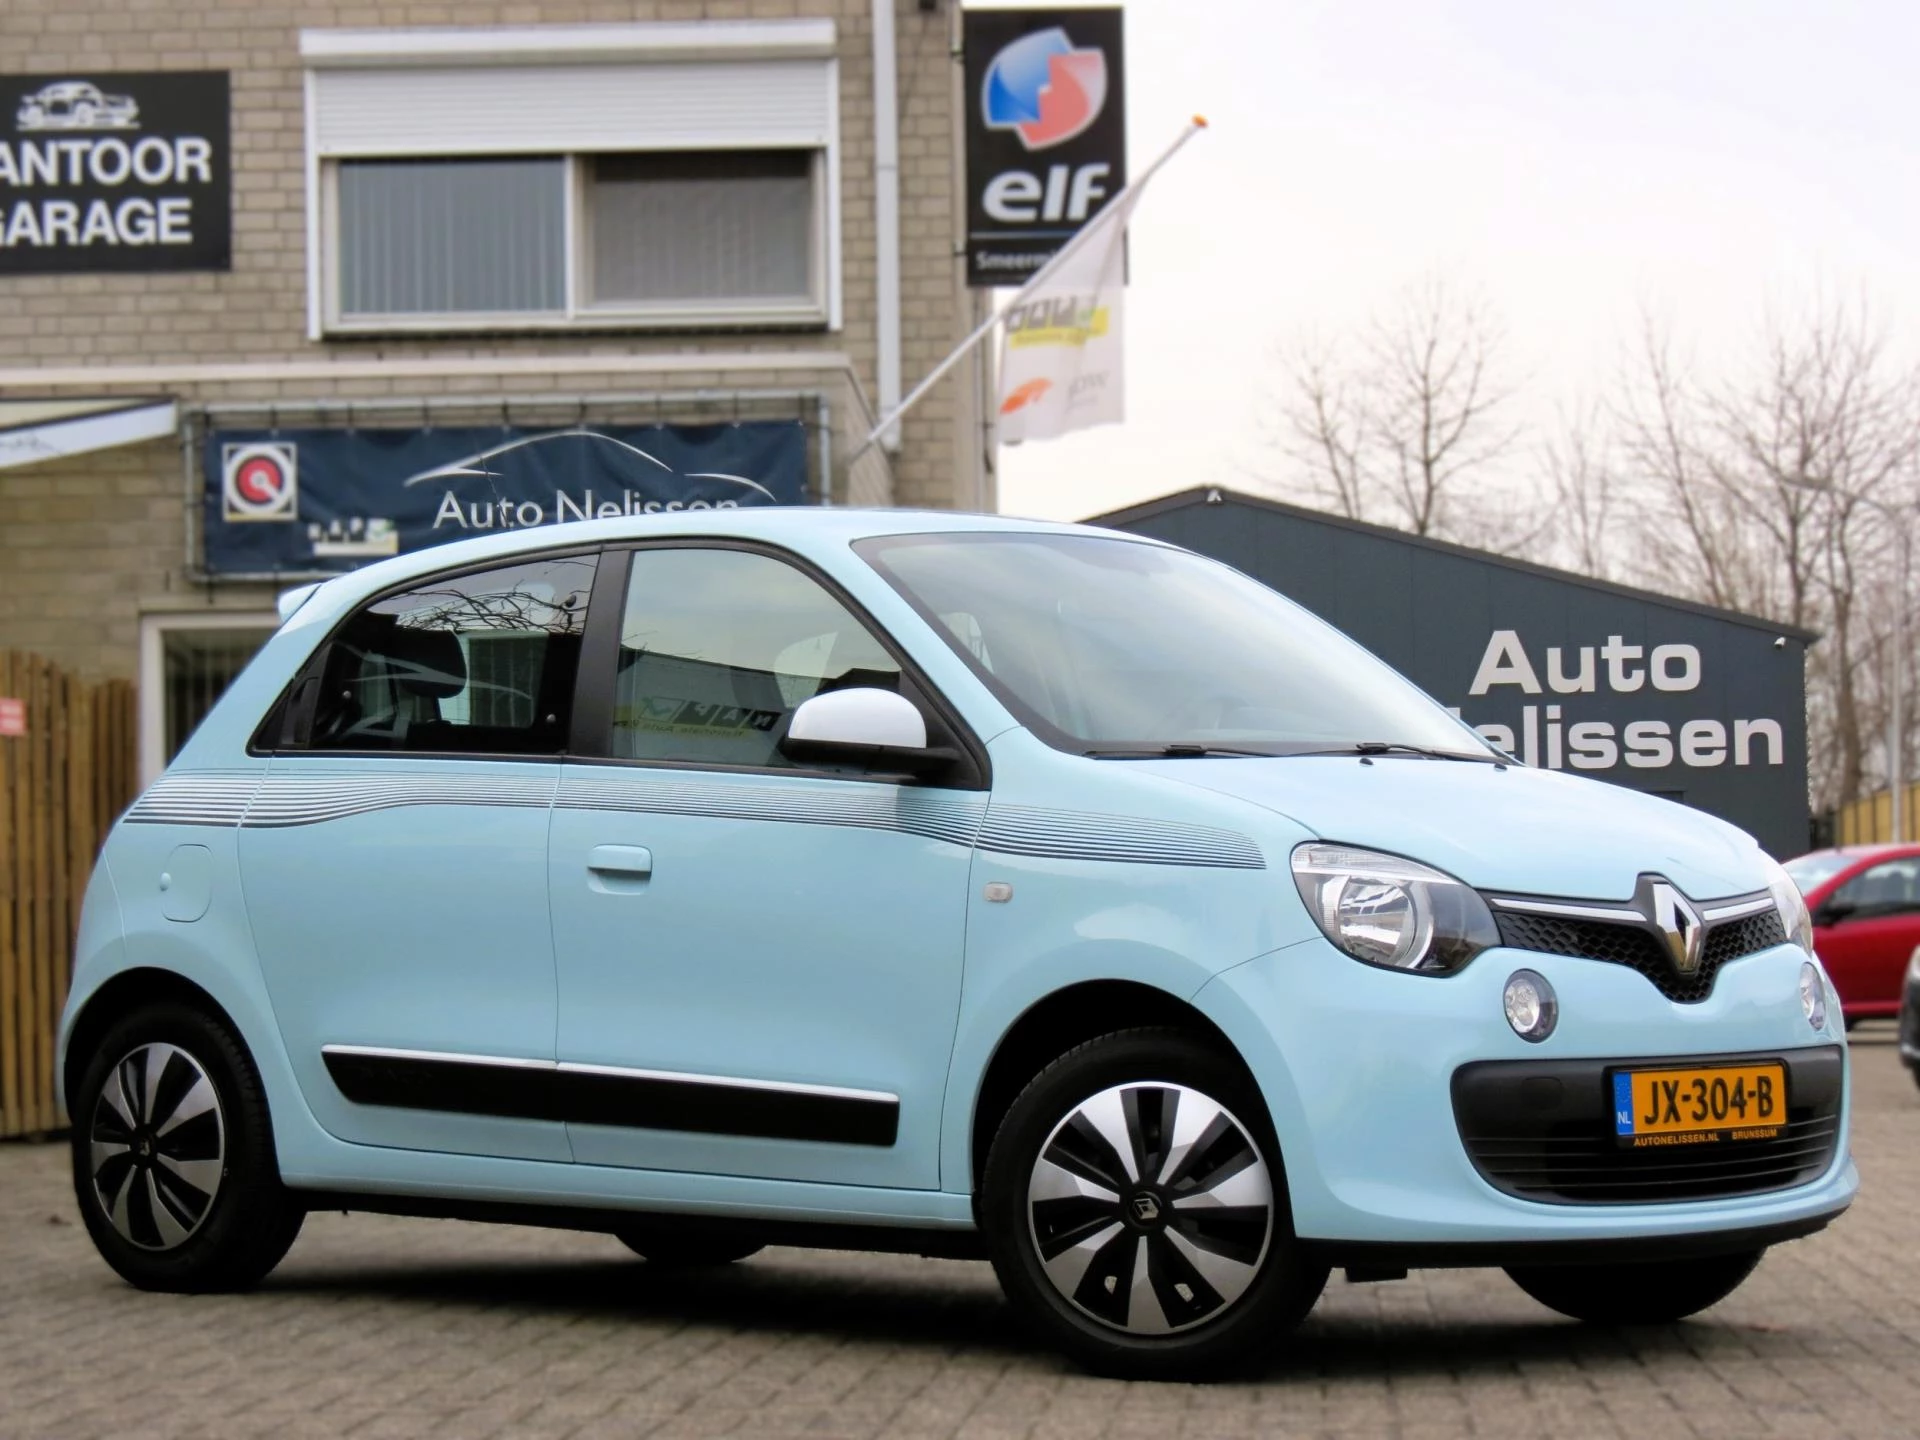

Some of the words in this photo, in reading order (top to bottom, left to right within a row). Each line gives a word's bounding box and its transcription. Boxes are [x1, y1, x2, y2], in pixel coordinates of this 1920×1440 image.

[982, 163, 1109, 222] elf
[0, 198, 193, 246] ARAGE
[975, 250, 1056, 270] Smeerm
[433, 490, 543, 529] Auto
[1468, 630, 1702, 695] Auto
[1449, 705, 1783, 769] elissen
[1618, 1111, 1632, 1125] NL
[1644, 1075, 1773, 1125] JX-304-B
[1634, 1132, 1719, 1147] AUTONELISSEN.NL
[1731, 1129, 1777, 1140] BRUNSSUM
